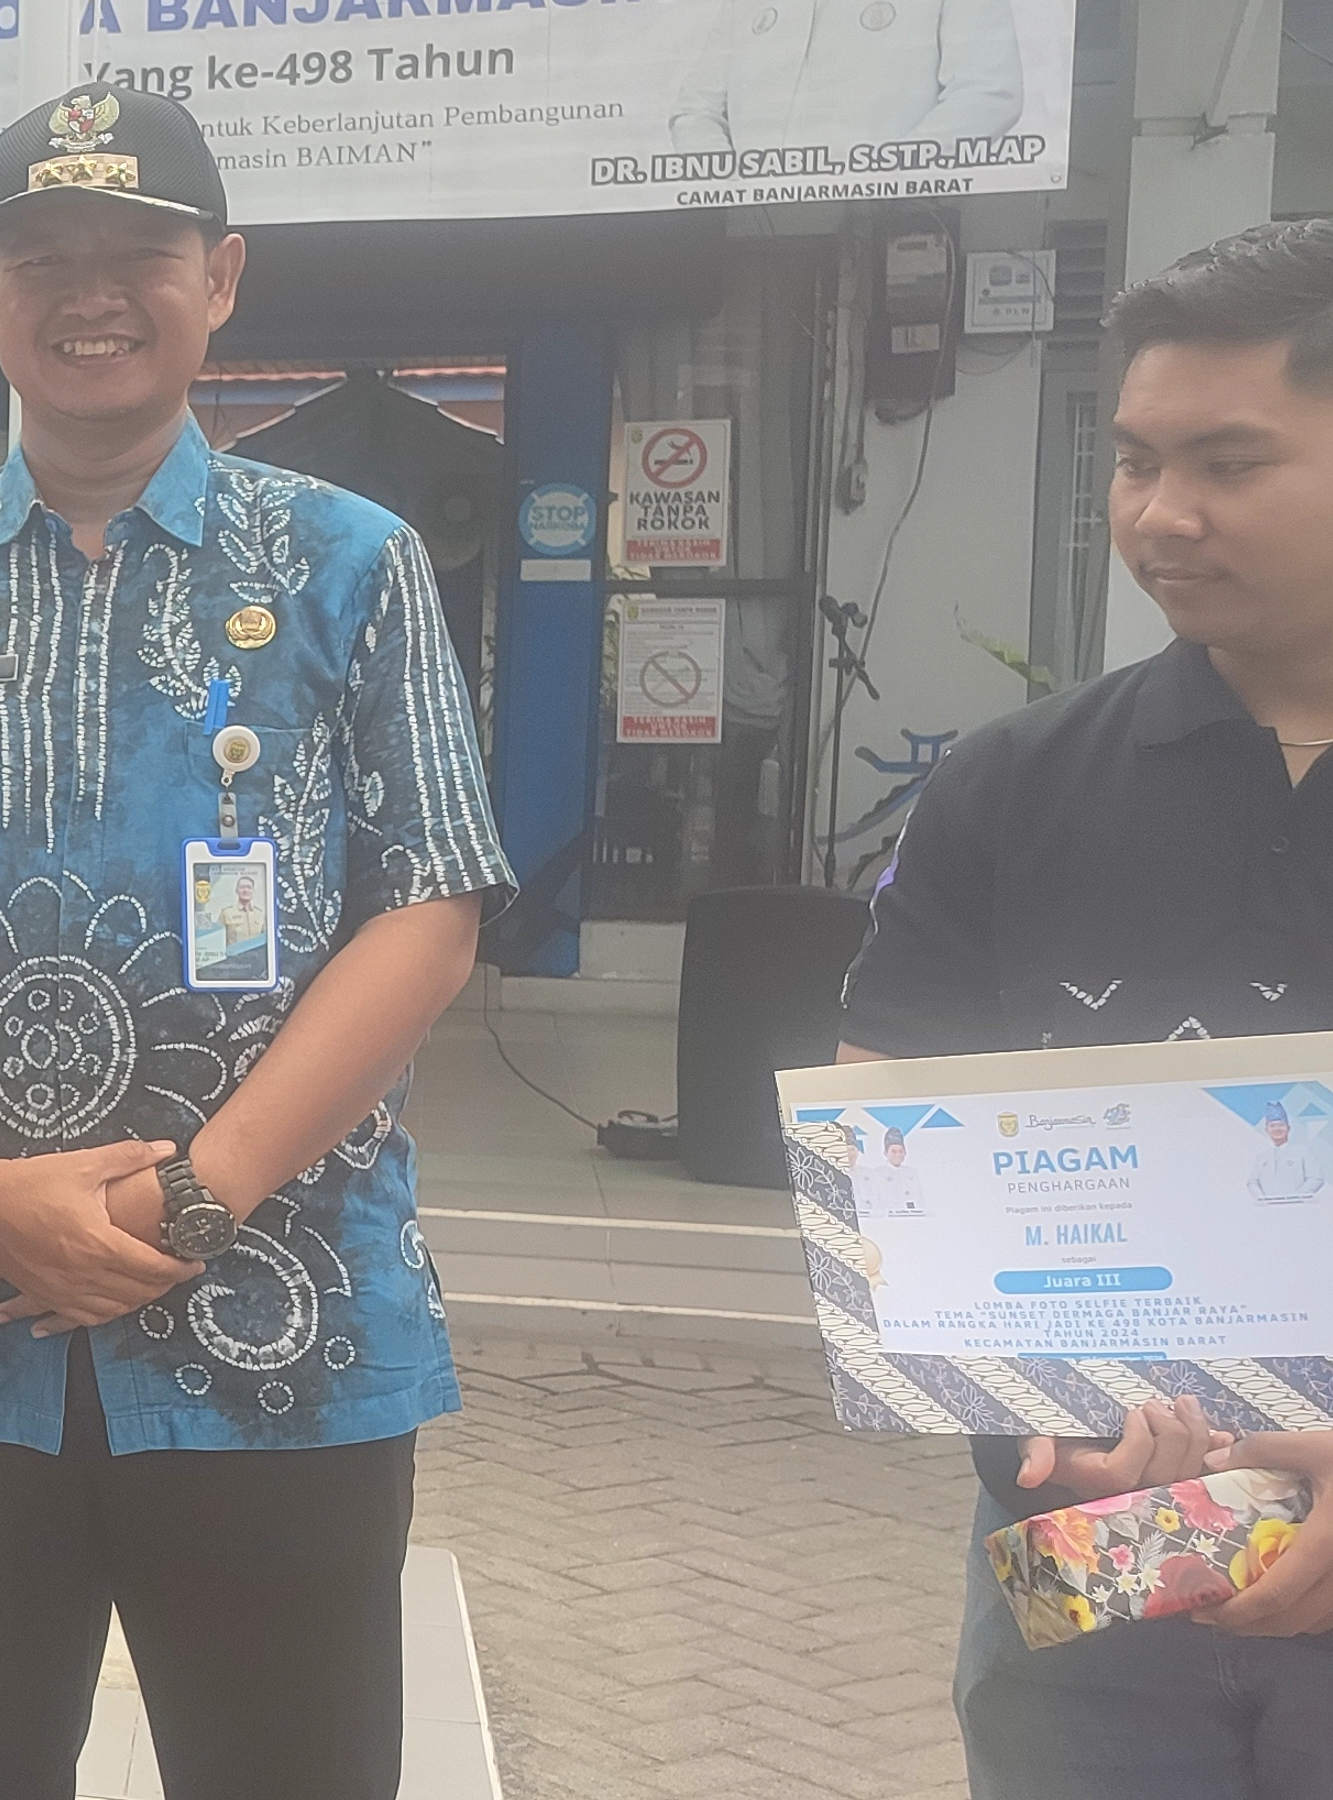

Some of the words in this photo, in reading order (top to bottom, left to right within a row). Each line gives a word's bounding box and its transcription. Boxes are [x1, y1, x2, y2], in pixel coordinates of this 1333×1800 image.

[208, 50, 353, 90] ke-498
[367, 43, 514, 82] Tahun
[201, 114, 253, 138] ntuk
[261, 110, 433, 138] Keberlanjutan
[443, 102, 623, 128] Pembangunan
[592, 158, 647, 185] DR.
[653, 153, 734, 181] IBNU
[740, 147, 845, 177] SABIL,
[676, 189, 746, 205] CAMAT
[753, 181, 898, 203] BANJARMASIN
[905, 178, 974, 194] BARAT
[629, 491, 720, 506] KAWASAN
[532, 505, 586, 521] STOP
[643, 505, 707, 518] TANPA
[637, 517, 710, 531] ROKOK
[992, 1144, 1139, 1176] PIAGAM
[1007, 1177, 1130, 1194] PENGHARGAAN
[1005, 1206, 1039, 1215] Piagam
[1041, 1204, 1052, 1212] ini
[1054, 1203, 1097, 1212] diberikan
[1099, 1202, 1132, 1212] kepada
[1025, 1225, 1049, 1247] M.
[1056, 1222, 1128, 1245] HAIKAL
[1061, 1255, 1097, 1265] sebagai
[1043, 1275, 1092, 1289] Juara
[1096, 1273, 1121, 1287] III
[974, 1301, 1022, 1311] LOMBA
[1031, 1300, 1067, 1310] FOTO
[1076, 1299, 1127, 1309] SELFIE
[1135, 1297, 1201, 1307] TERBAIK
[883, 1319, 931, 1328] DALAM
[938, 1320, 996, 1329] RANGKA
[1003, 1320, 1039, 1329] HARI
[1047, 1319, 1080, 1329] JADI
[1088, 1319, 1105, 1328] KE
[1113, 1318, 1141, 1328] 498
[1148, 1317, 1188, 1327] KOTA
[1195, 1312, 1308, 1325] BANJARMASIN
[935, 1311, 973, 1320] TEMA
[1053, 1309, 1125, 1319] DERMAGA
[1133, 1307, 1191, 1318] BANJAR
[1044, 1329, 1094, 1338] TAHUN
[1102, 1328, 1139, 1337] 2024
[964, 1339, 1054, 1348] KECAMATAN
[1061, 1337, 1169, 1348] BANJARMASIN
[1177, 1335, 1227, 1346] BARAT
